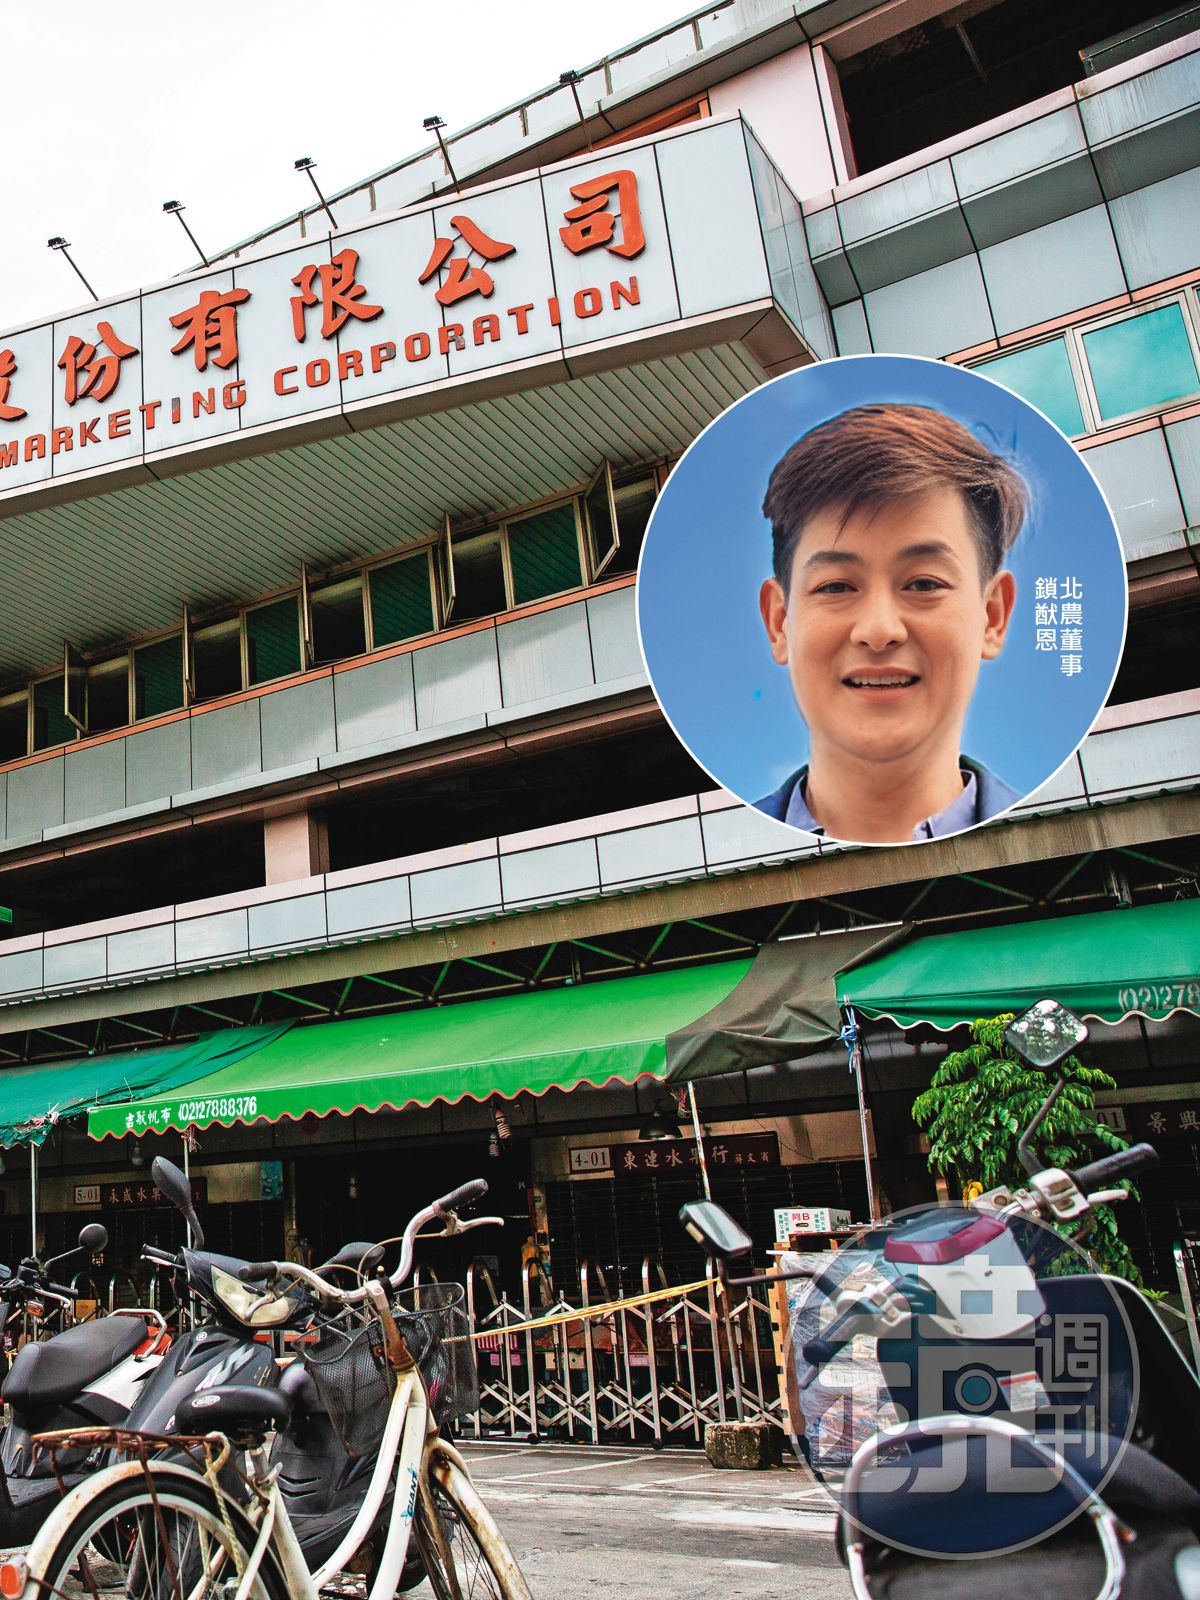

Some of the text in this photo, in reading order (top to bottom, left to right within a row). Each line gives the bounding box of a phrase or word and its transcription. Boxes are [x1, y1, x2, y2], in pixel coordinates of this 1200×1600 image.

[274, 275, 642, 396] CORPORATION
[178, 1096, 257, 1121] (02)27888376
[574, 1152, 609, 1167] 4-01
[77, 1189, 98, 1201] 5-01
[406, 1471, 419, 1517] GIANT
